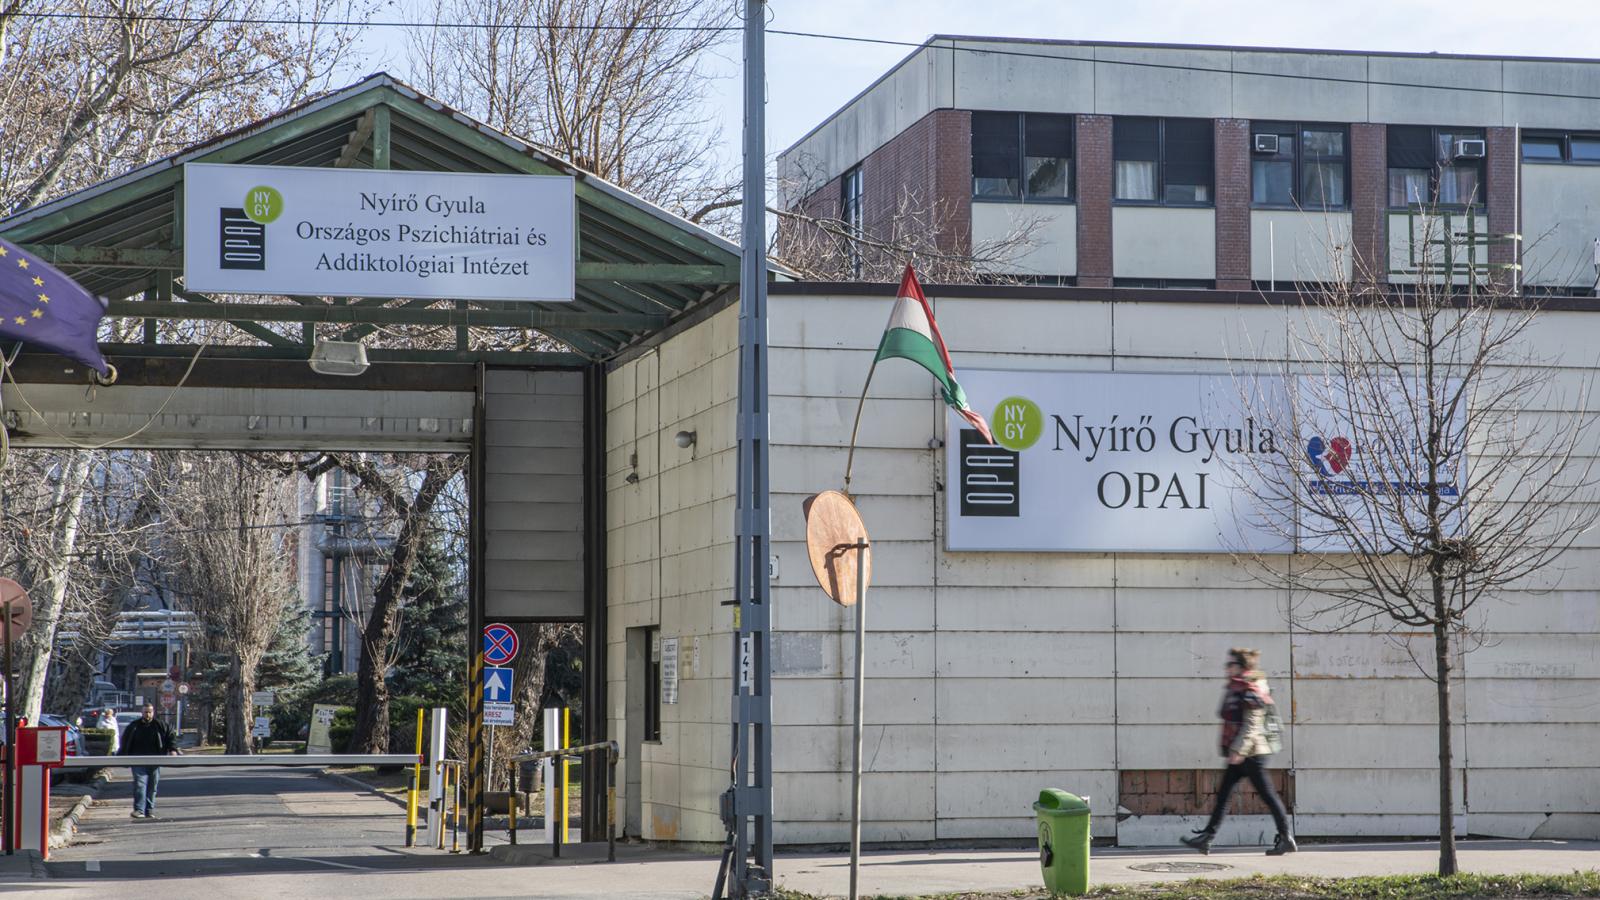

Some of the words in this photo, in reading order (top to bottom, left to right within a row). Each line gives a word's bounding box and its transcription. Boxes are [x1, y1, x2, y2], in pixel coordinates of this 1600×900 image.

[254, 191, 270, 204] NY
[360, 193, 418, 215] Nyírő
[425, 195, 486, 217] Gyula
[254, 204, 270, 217] GY
[296, 222, 391, 245] Országos
[398, 224, 520, 247] Pszichiátriai
[526, 229, 547, 246] és
[315, 252, 455, 277] Addiktológiai
[463, 256, 530, 276] Intézet
[1005, 405, 1026, 421] NY
[1005, 423, 1026, 440] GY
[1050, 414, 1156, 462] Nyírő
[1169, 415, 1276, 464] Gyula
[1097, 471, 1210, 509] OPAI
